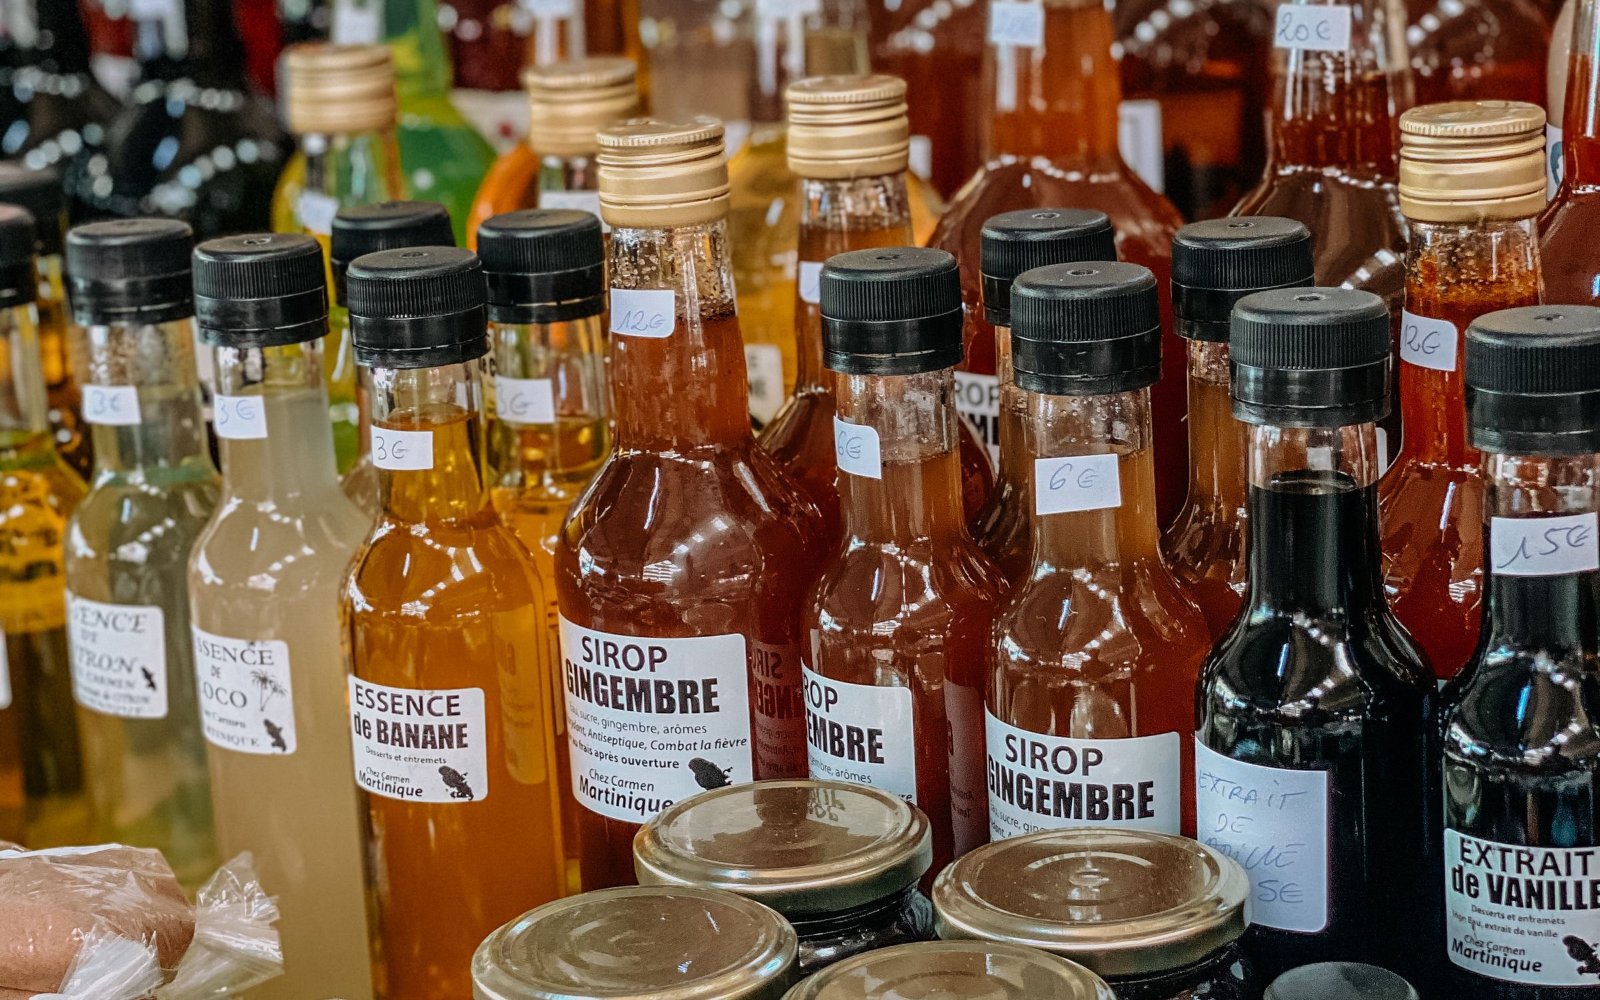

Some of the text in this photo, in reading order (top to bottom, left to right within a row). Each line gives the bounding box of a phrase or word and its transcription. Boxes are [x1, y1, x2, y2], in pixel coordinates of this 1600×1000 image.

[1278, 11, 1332, 42] 20€
[375, 435, 408, 461] 3€
[837, 430, 862, 460] 6€
[1496, 524, 1592, 569] 15€
[582, 635, 667, 673] SIROP
[211, 665, 220, 679] DE
[355, 683, 461, 716] ESSENCE
[566, 658, 720, 714] GINGEMBRE
[354, 711, 469, 749] de BANANE
[588, 728, 648, 751] Antiseptique,
[650, 739, 698, 751] Combat
[700, 739, 711, 750] la
[714, 737, 747, 749] fièvre
[601, 718, 659, 735] gingembre,
[663, 723, 707, 735] arômes
[365, 746, 447, 764] Desserts et entremets
[594, 749, 619, 763] après
[621, 755, 679, 769] ouverture
[1005, 733, 1103, 776] SIROP
[359, 769, 423, 798] Martinique
[366, 766, 380, 777] Chez
[589, 768, 655, 792] Chez Carmen
[835, 768, 872, 784] arômes
[580, 774, 674, 816] Martinique
[988, 753, 1155, 821] GINGEMBRE
[1000, 811, 1021, 830] sucre,
[1214, 813, 1254, 833] DE
[1459, 836, 1595, 877] EXTRAIT
[1452, 864, 1600, 910] de VANILLE
[1471, 904, 1505, 920] Desserts
[1518, 915, 1566, 925] entremets
[1464, 934, 1484, 948] Chez
[1485, 923, 1512, 933] extrait
[1514, 927, 1525, 936] de
[1527, 928, 1559, 938] vanille
[1452, 937, 1542, 973] Martinique
